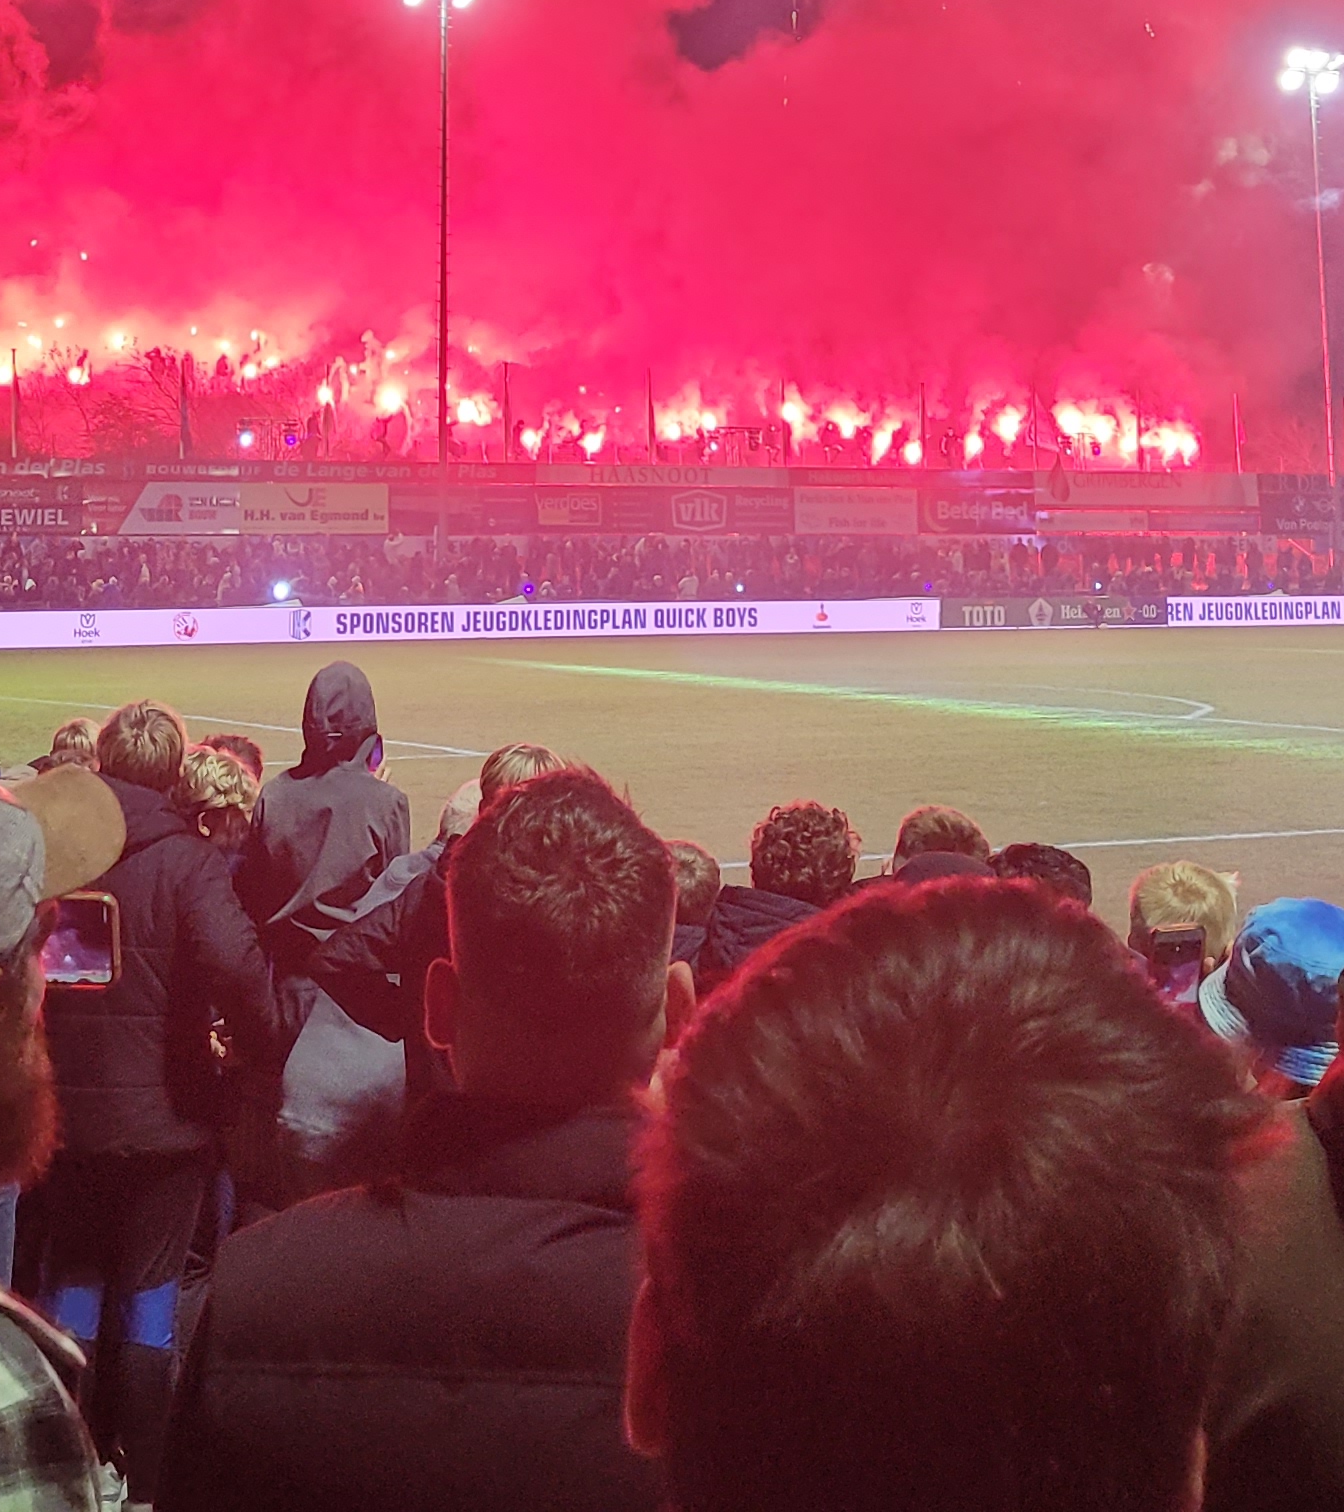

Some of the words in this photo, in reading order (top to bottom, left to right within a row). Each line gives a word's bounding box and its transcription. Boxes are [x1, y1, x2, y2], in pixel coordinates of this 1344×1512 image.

[58, 459, 106, 476] Plas
[273, 462, 300, 478] de
[307, 463, 412, 481] Lange-van
[417, 465, 449, 480] de
[457, 464, 498, 479] Plas
[590, 467, 713, 484] HAASNOOT
[535, 492, 599, 514] verdoes
[678, 497, 721, 523] vlk
[734, 494, 789, 510] Recycling
[936, 501, 988, 520] Beter
[991, 500, 1028, 521] Bed
[243, 509, 276, 522] H.H.
[279, 511, 307, 522] van
[309, 508, 369, 524] Egmond
[828, 516, 850, 529] Fish
[1275, 517, 1298, 531] Van
[962, 604, 1006, 627] TOTO
[1198, 600, 1342, 623] JEUGDKLEDINGPLAN
[335, 610, 456, 636] SPONSOREN
[461, 607, 648, 633] JEUGDKLEDINGPLAN
[654, 606, 708, 630] QUICK
[713, 606, 759, 629] BOYS
[72, 626, 101, 639] Hoek
